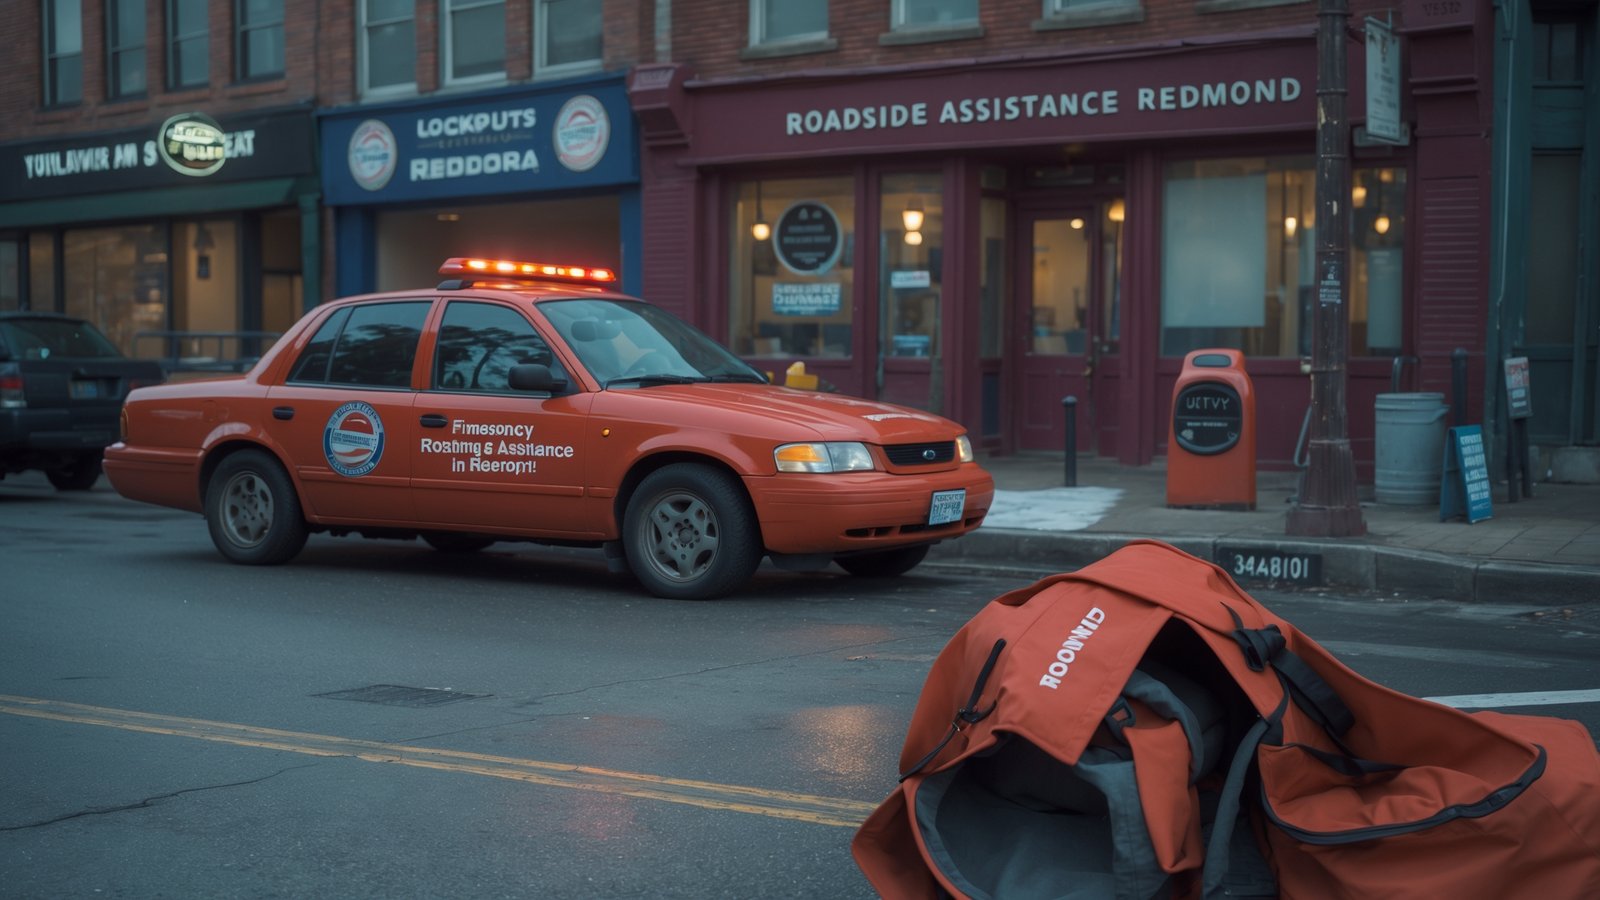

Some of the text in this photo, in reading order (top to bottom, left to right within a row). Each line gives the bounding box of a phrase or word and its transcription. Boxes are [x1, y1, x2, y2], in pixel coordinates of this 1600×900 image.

[786, 77, 1302, 136] ROADSIDE ASSISTANCE REDMOND
[409, 150, 539, 182] REDDORA
